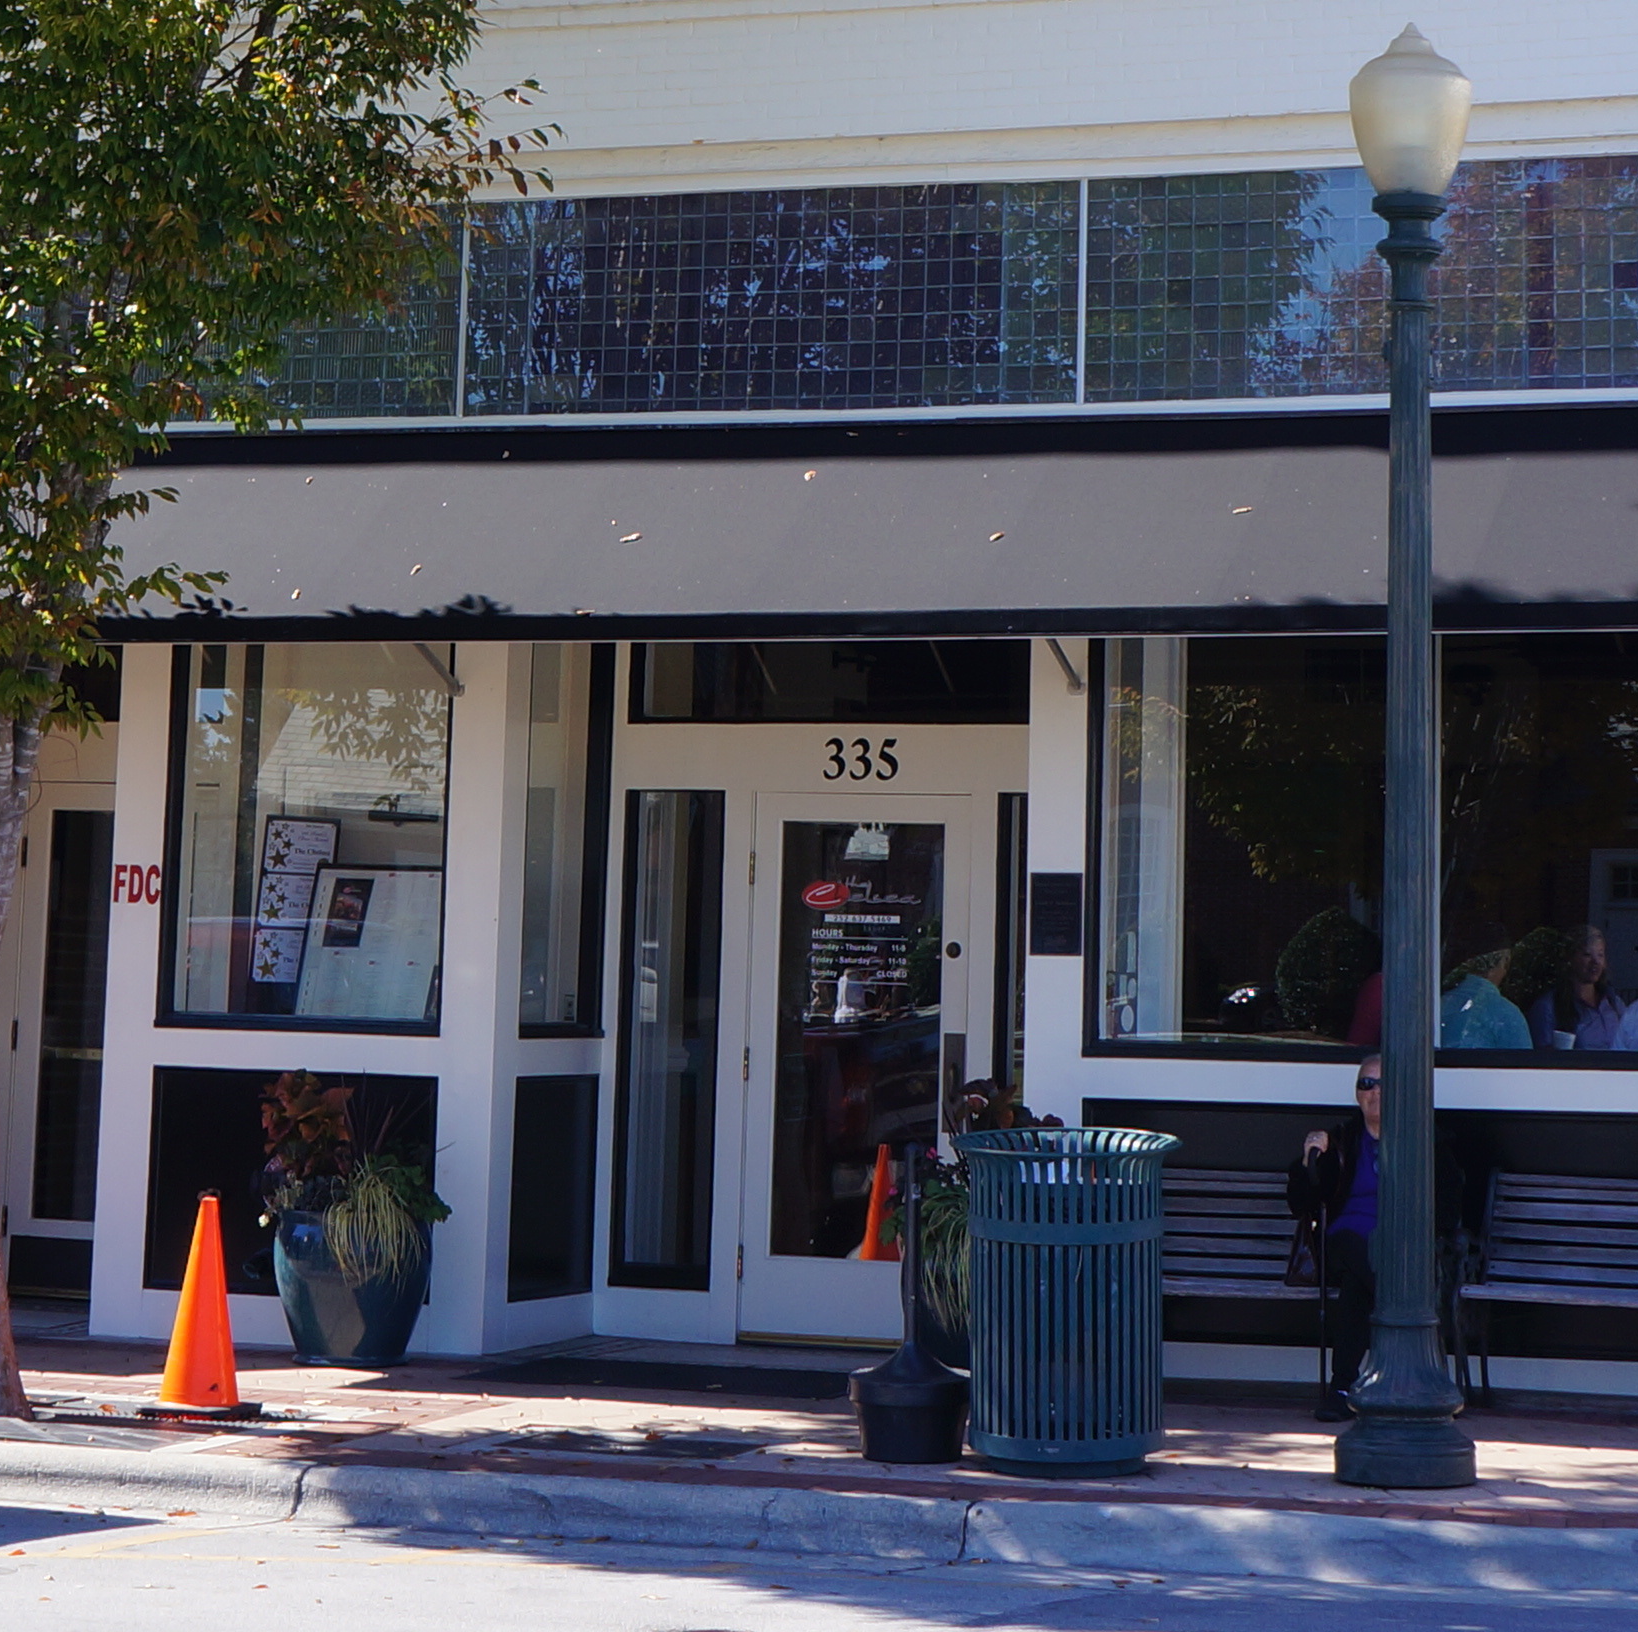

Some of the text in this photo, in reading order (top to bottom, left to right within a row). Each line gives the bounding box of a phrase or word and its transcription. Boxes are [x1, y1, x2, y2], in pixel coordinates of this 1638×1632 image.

[822, 737, 899, 781] 335
[112, 864, 161, 905] FDC
[811, 928, 844, 937] HOURS
[811, 943, 840, 952] Monday
[845, 943, 878, 953] Thursday
[811, 956, 834, 965] Friday
[839, 956, 871, 967] Saturday
[811, 968, 908, 978] Sunday CLOSED
